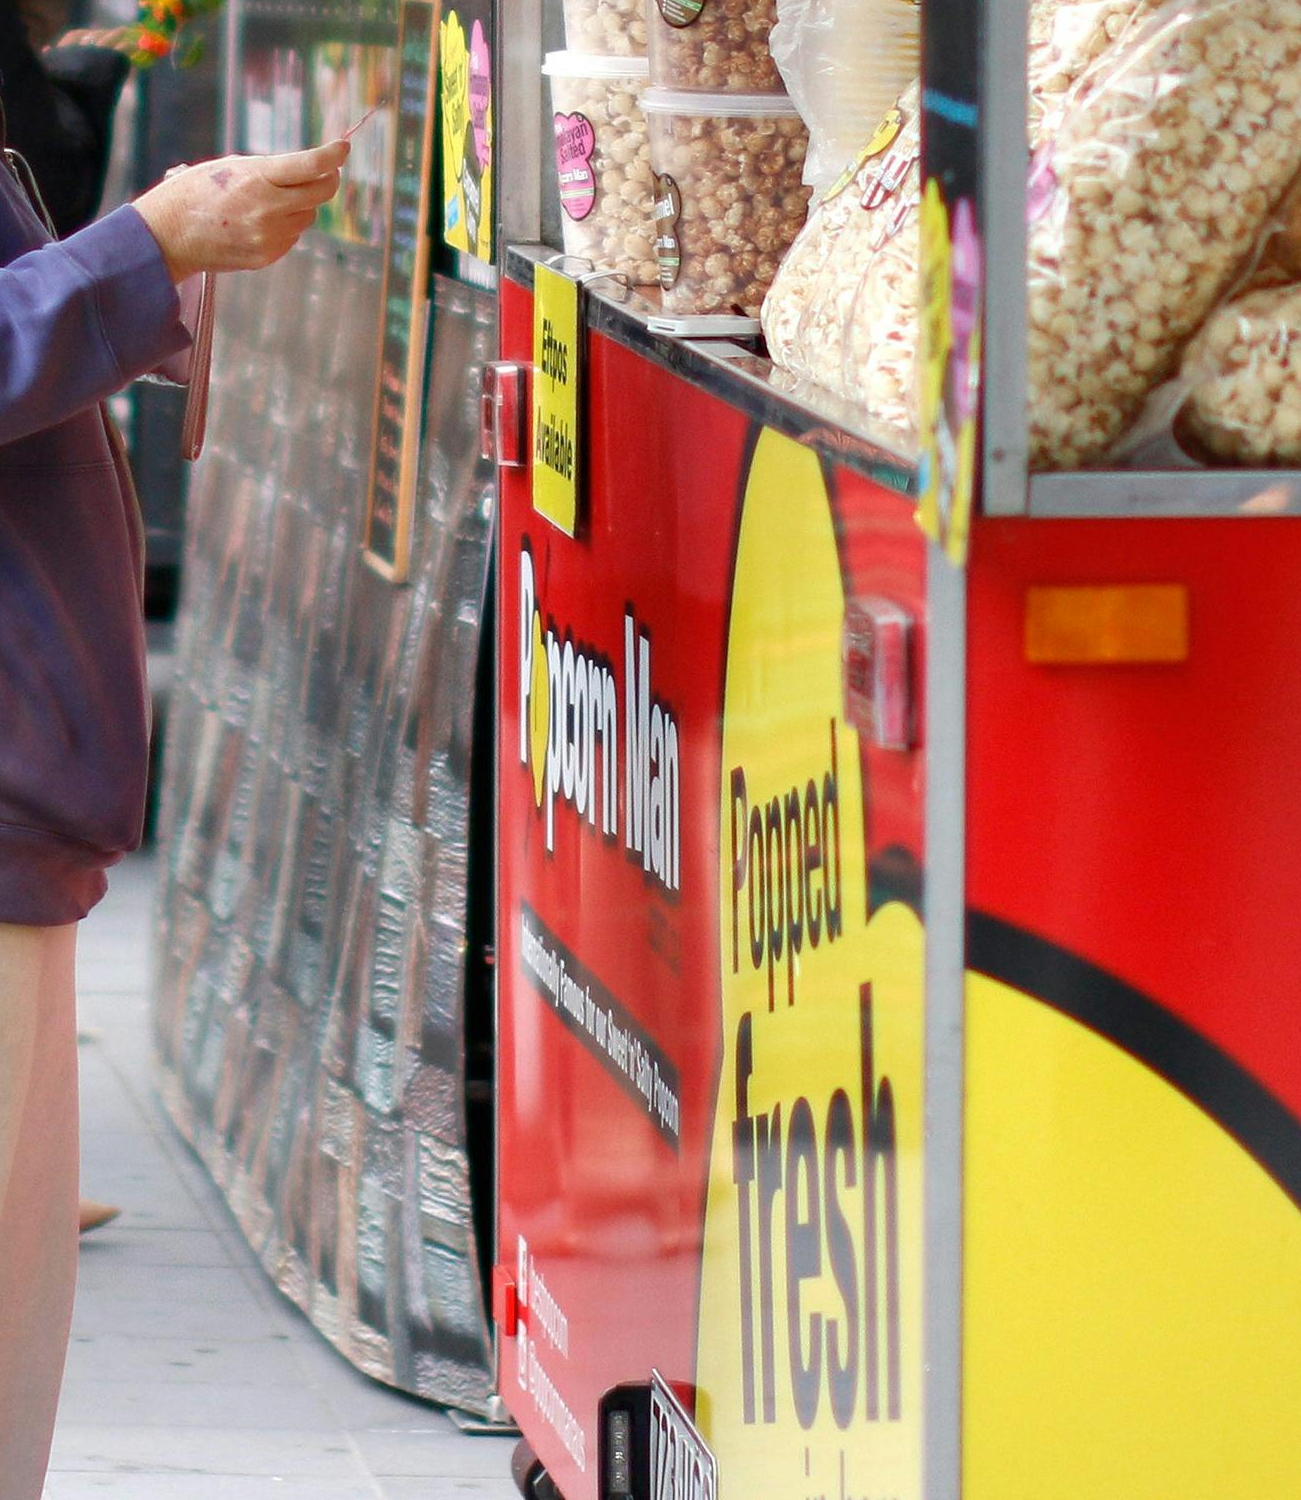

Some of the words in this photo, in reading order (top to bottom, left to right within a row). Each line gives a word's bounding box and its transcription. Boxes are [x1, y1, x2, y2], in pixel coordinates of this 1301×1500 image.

[561, 141, 586, 165] Salted
[542, 317, 568, 393] Eftpos
[536, 407, 573, 482] Available
[519, 550, 617, 853] Popcorn
[625, 613, 680, 891] Man
[729, 717, 843, 1013] Popped
[560, 959, 585, 1026] Famous
[607, 1009, 628, 1075] Sweet
[637, 1040, 653, 1112] Salty
[653, 1061, 679, 1137] Popcorn
[732, 980, 901, 1430] fresh
